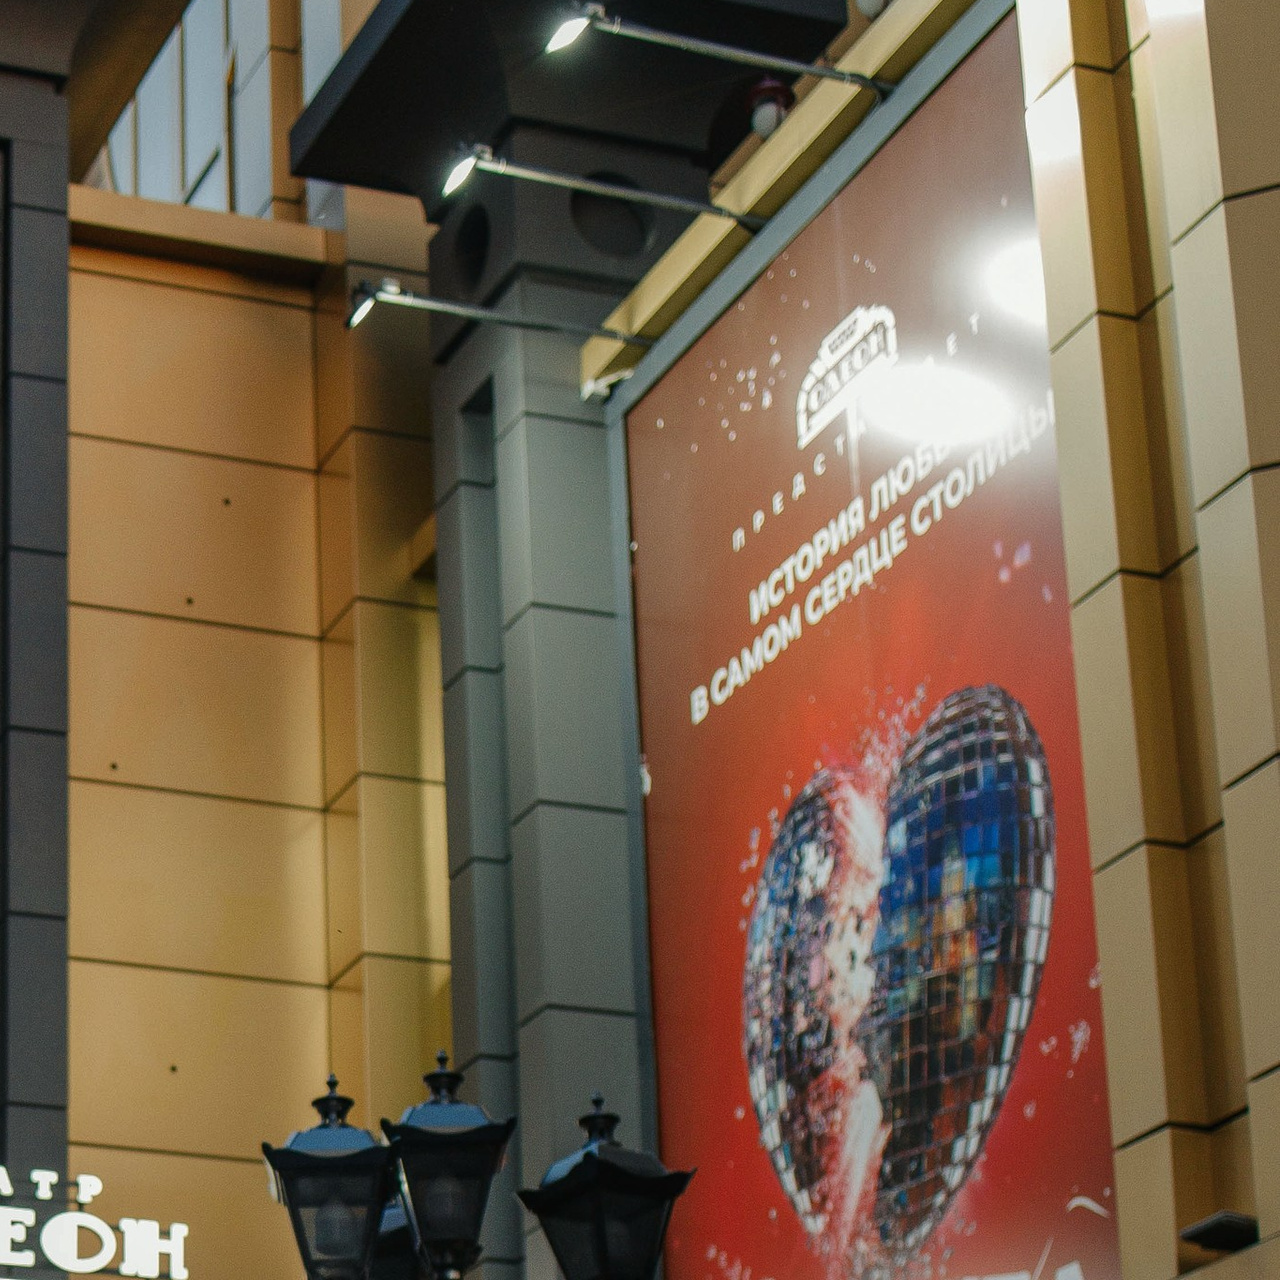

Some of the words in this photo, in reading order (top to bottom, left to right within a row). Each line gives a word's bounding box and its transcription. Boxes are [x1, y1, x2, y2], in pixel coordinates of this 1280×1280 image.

[689, 684, 710, 725] В
[709, 603, 802, 707] САМОМ
[805, 513, 908, 626] СЕРДЦЕ
[748, 495, 865, 625] ИСТОРИЯ
